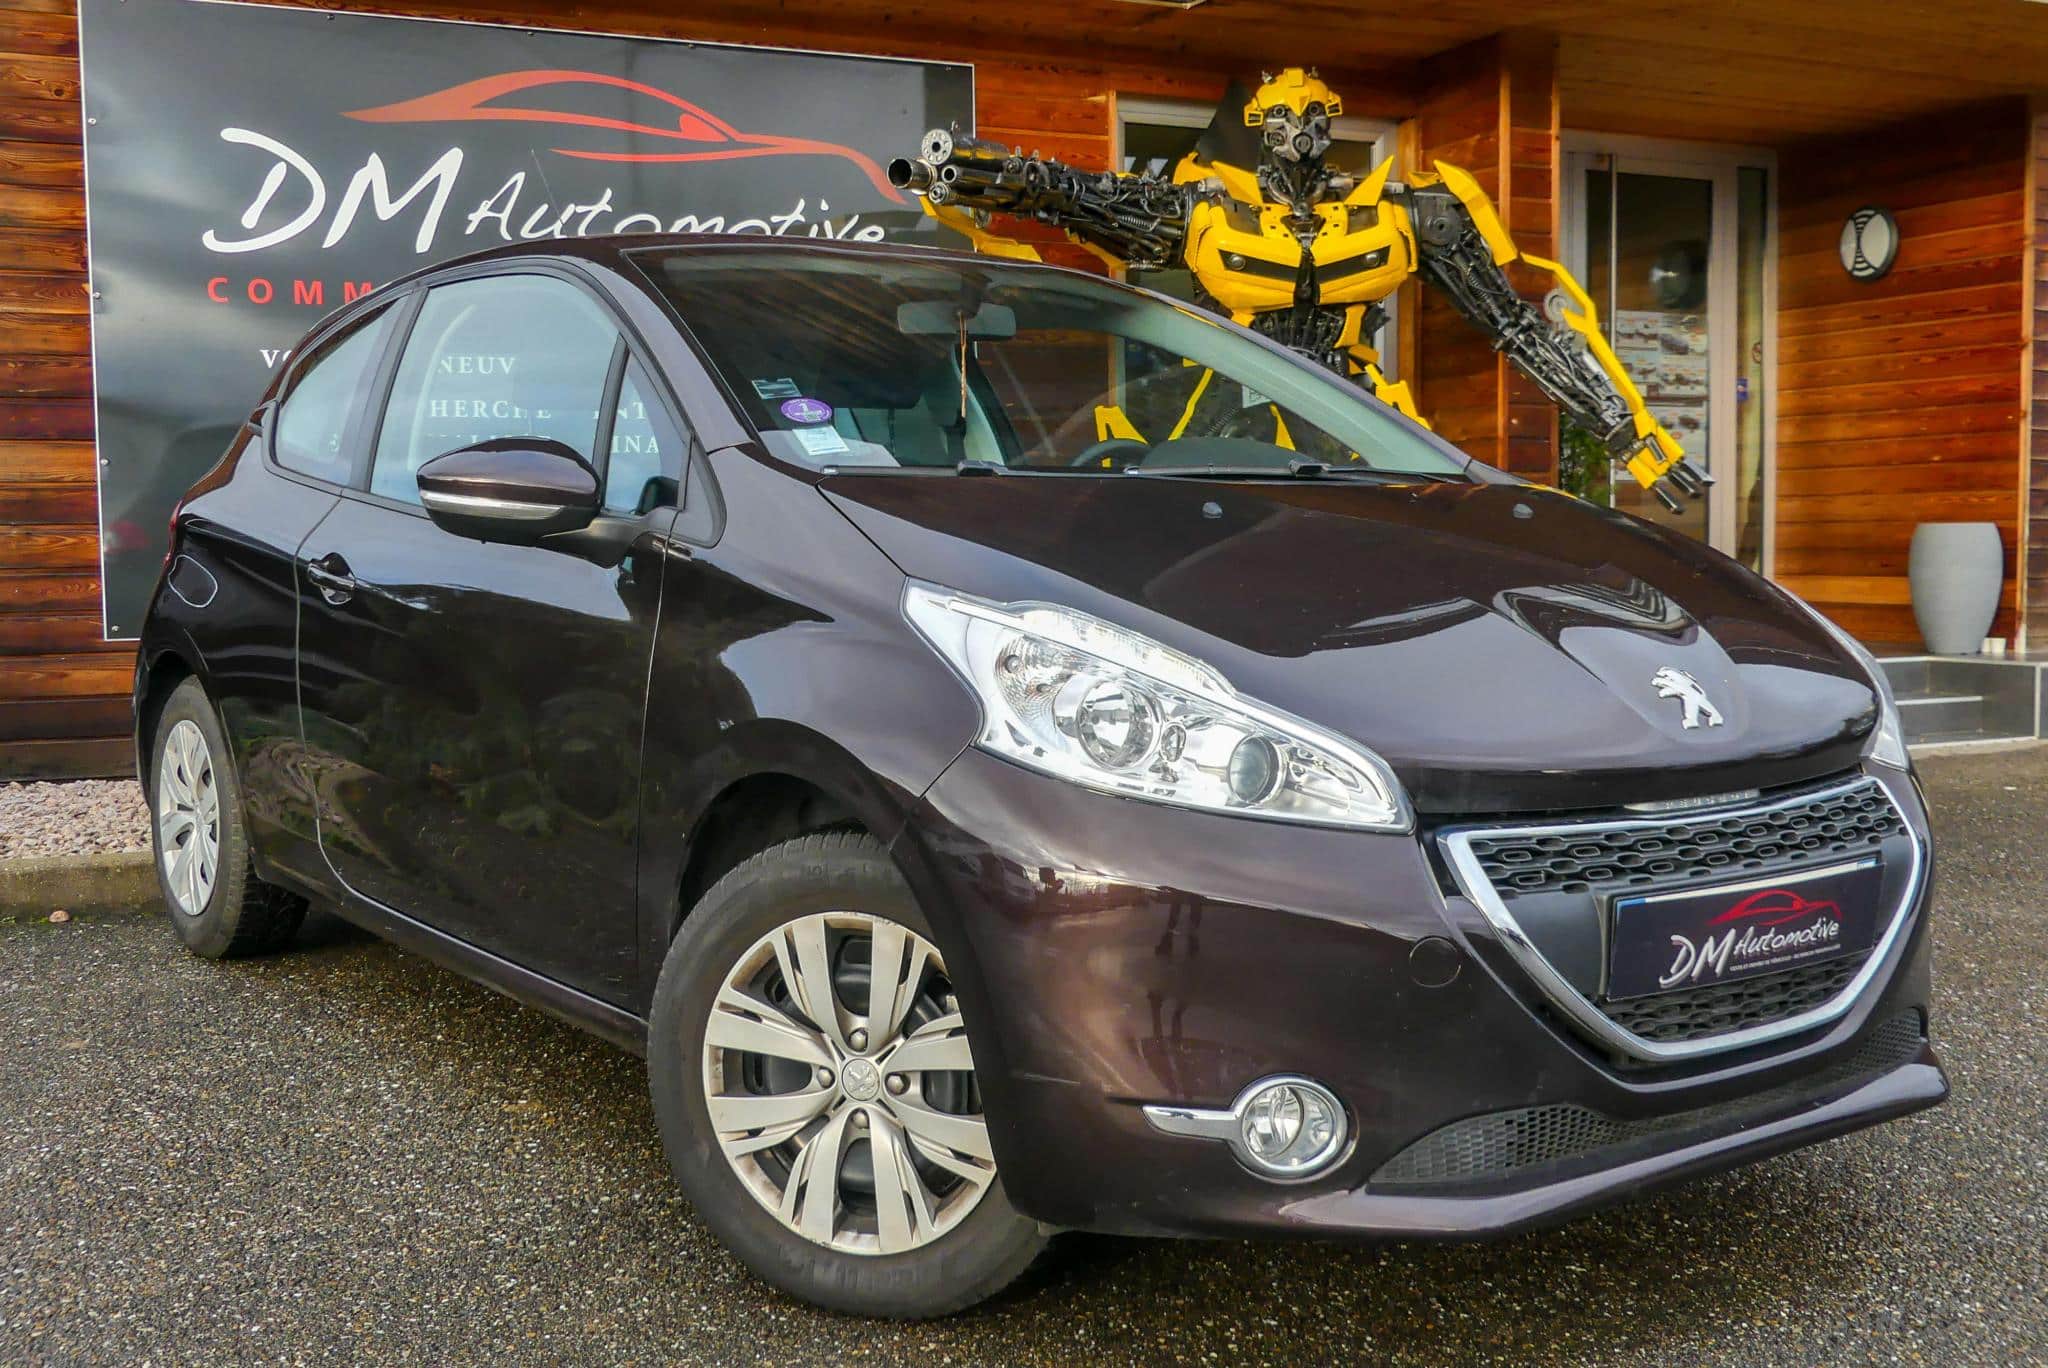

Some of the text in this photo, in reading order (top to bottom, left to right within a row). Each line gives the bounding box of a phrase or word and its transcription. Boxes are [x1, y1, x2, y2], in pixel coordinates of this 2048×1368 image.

[202, 127, 464, 253] DM
[1659, 928, 1737, 988] DM
[1733, 917, 1841, 957] Automotive
